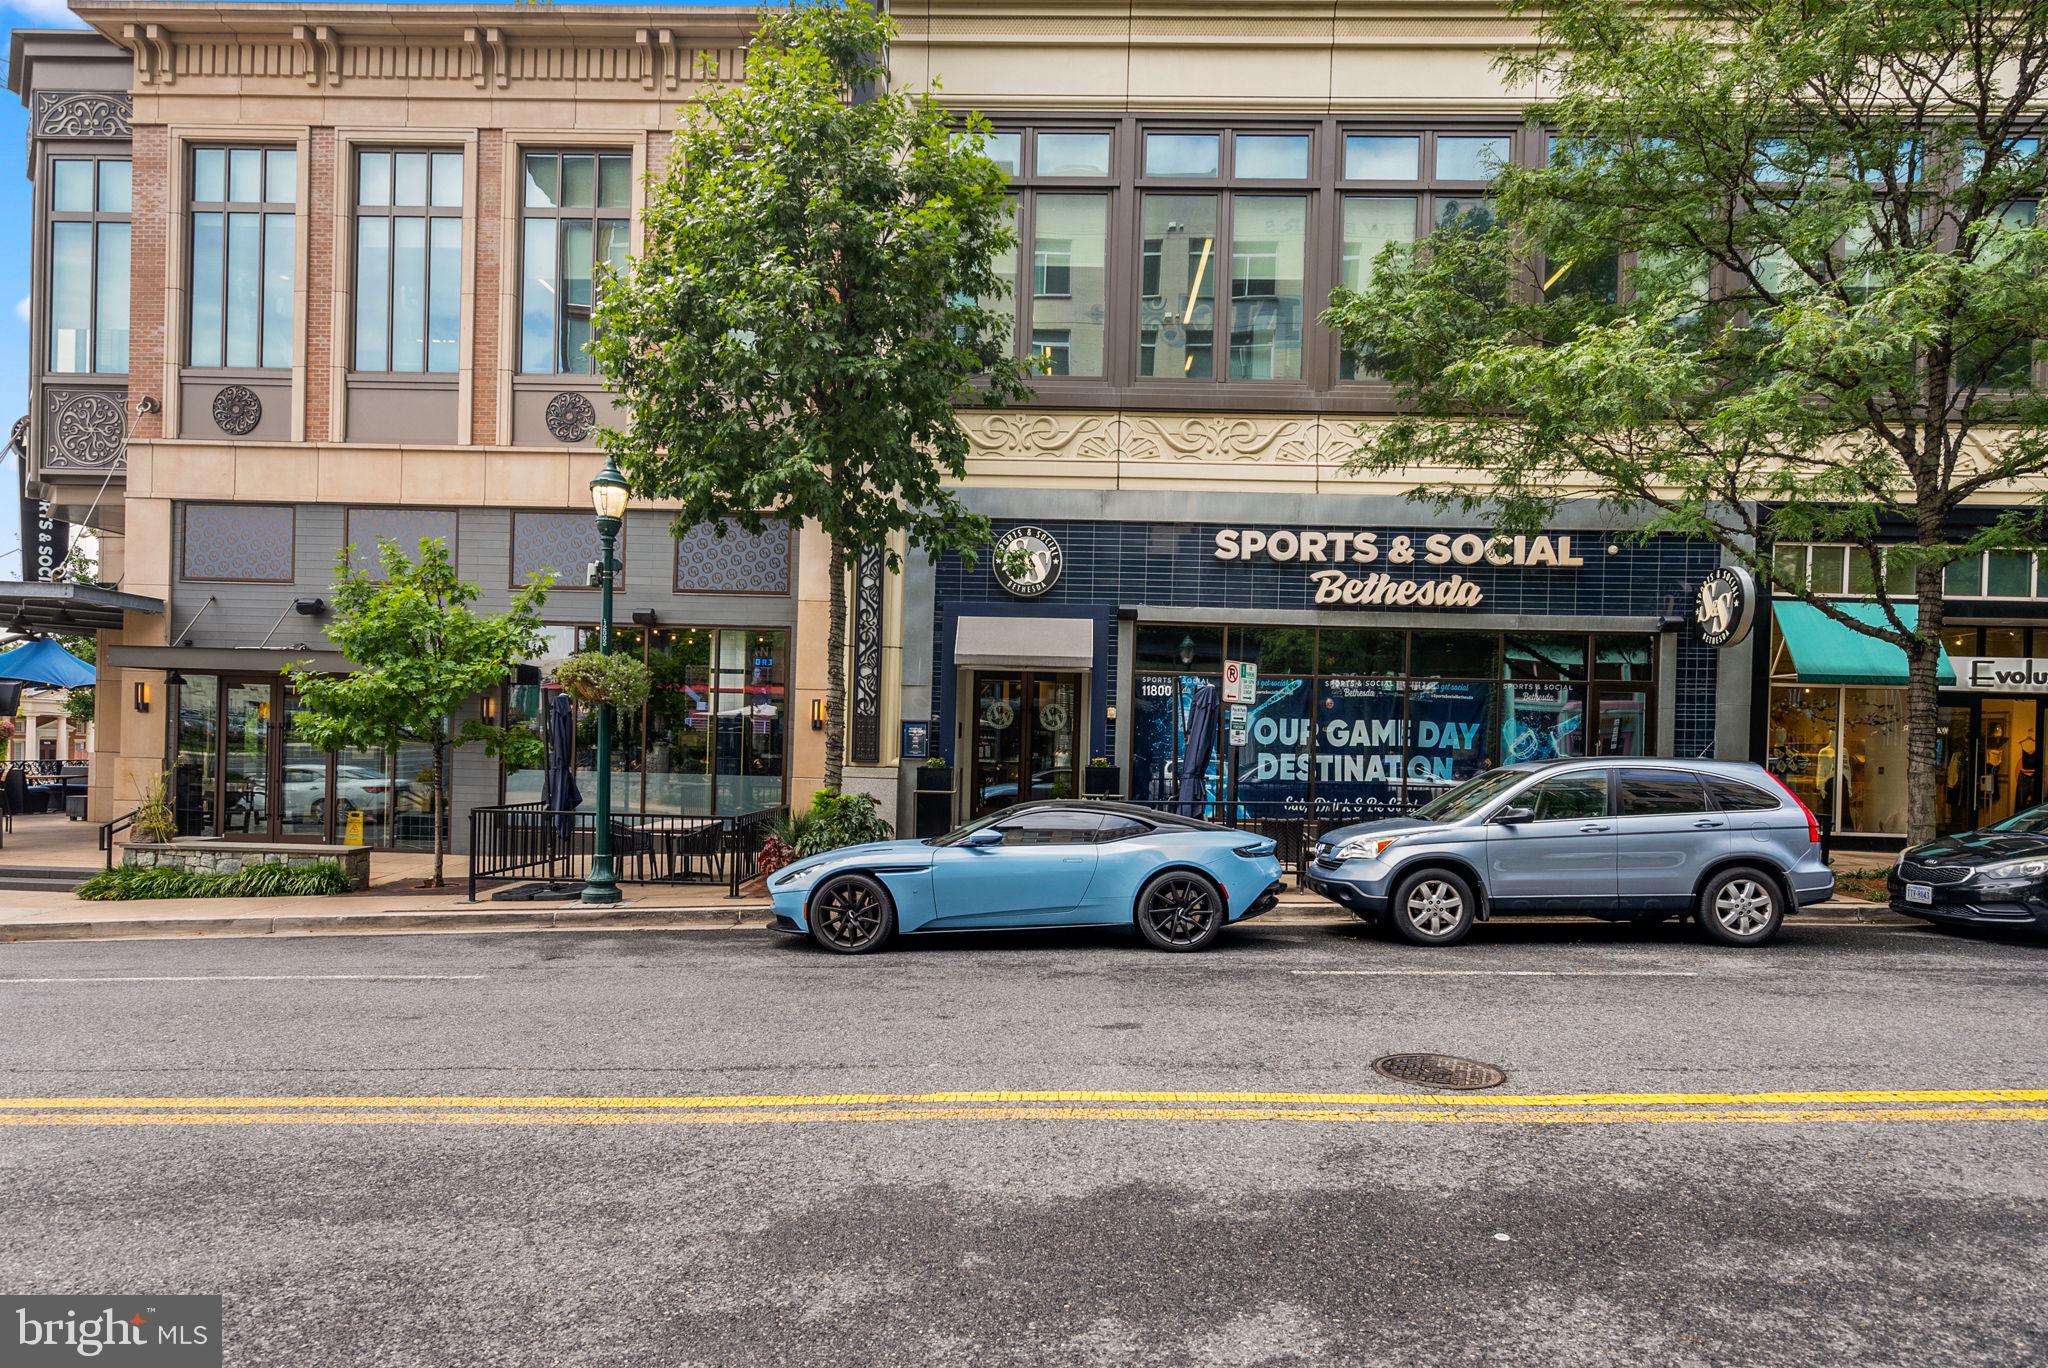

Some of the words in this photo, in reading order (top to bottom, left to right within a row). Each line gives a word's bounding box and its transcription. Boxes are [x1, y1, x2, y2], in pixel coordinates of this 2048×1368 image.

[39, 533, 52, 542] &
[999, 529, 1022, 550] PORTS
[1027, 528, 1032, 536] &
[1036, 531, 1059, 557] SOCIAL
[1214, 529, 1379, 563] SPORTS
[1387, 535, 1415, 564] &
[1424, 533, 1584, 567] SOCIAL
[1007, 580, 1046, 593] BETHESDA
[1310, 569, 1484, 607] Bethesda
[1696, 573, 1714, 604] SPORTS
[1722, 570, 1739, 597] SOCIAL
[1702, 629, 1730, 644] BETHESDA
[1969, 659, 2048, 687] Evolu
[1142, 685, 1172, 696] 11800
[1343, 688, 1375, 697] Bethesda
[1440, 684, 1450, 692] get
[1523, 691, 1554, 701] Bethesda
[1254, 717, 1320, 747] OUR
[1418, 720, 1480, 750] DAY
